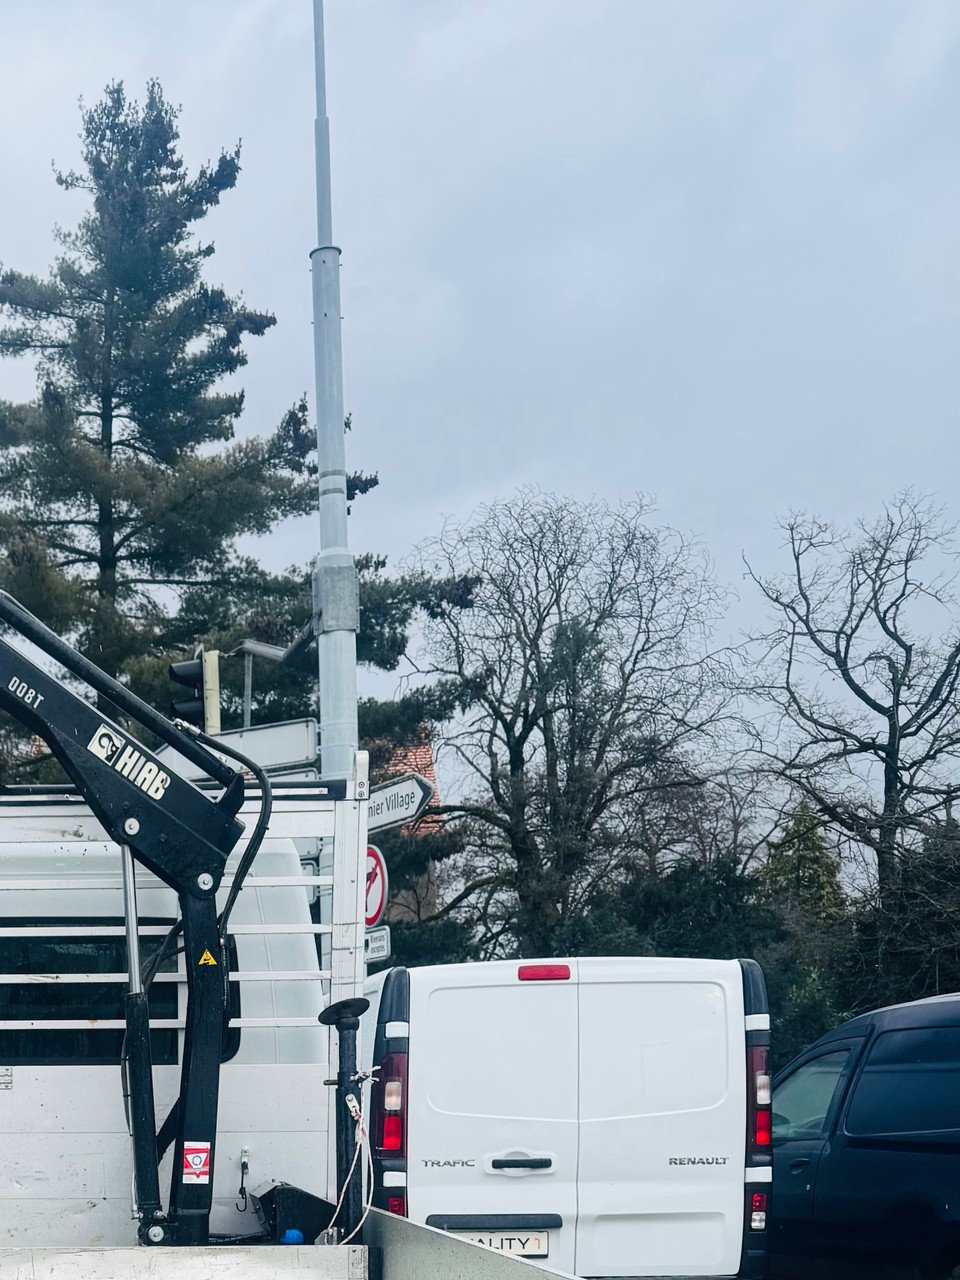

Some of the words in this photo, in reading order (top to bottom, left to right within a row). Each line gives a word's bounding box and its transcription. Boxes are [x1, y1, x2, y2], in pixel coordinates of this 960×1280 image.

[114, 745, 171, 800] HIAB
[385, 791, 416, 812] Village
[421, 1159, 476, 1168] TRAFIC
[668, 1157, 730, 1166] RENAULT
